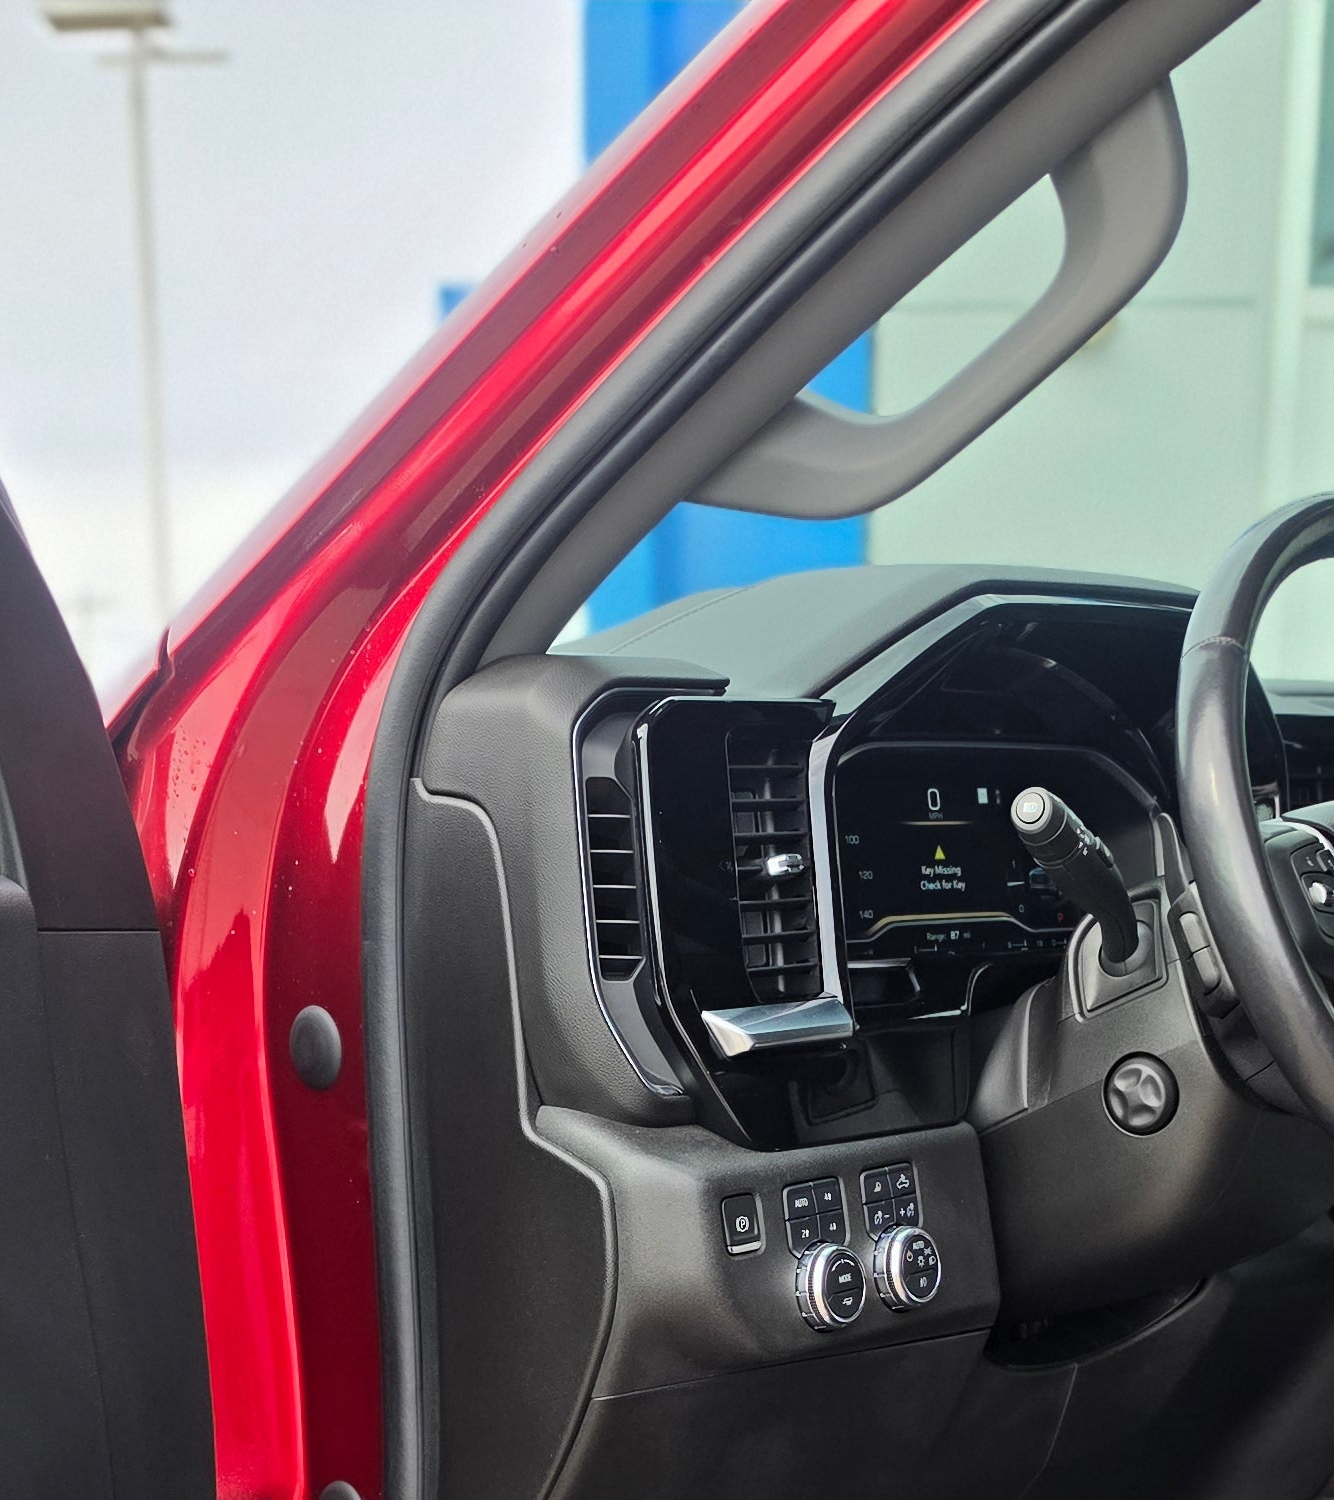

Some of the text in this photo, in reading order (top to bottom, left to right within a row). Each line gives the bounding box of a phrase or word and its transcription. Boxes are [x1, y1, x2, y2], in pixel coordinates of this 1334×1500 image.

[927, 788, 940, 811] 0
[845, 835, 860, 845] 100
[859, 870, 873, 880] 120
[921, 865, 962, 877] Key Missing
[920, 879, 966, 892] Check for Key
[859, 909, 874, 919] 140
[794, 1197, 809, 1208] AUTO
